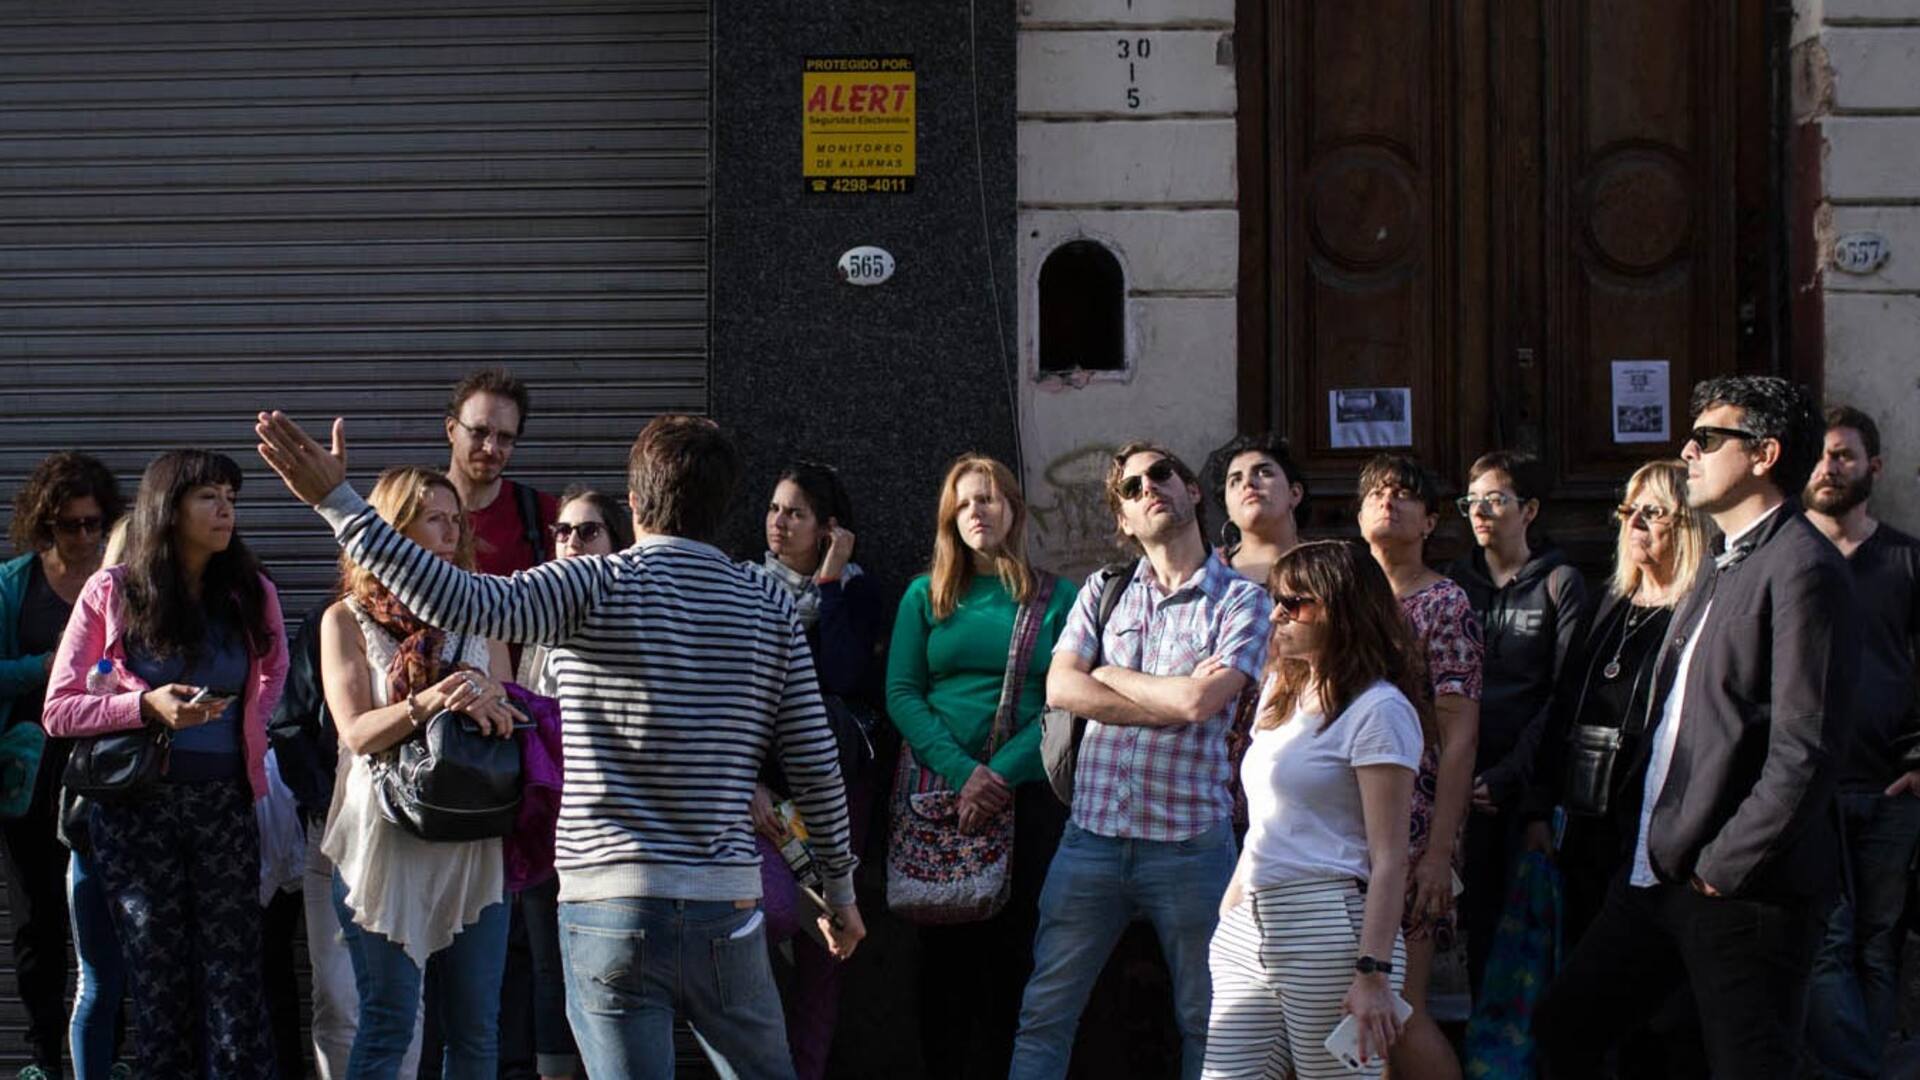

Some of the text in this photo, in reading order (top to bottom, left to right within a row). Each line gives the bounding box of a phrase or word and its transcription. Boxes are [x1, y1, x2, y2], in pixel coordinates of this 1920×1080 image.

[806, 59, 912, 70] PROTEGIDO POR:
[807, 84, 911, 113] ALERT
[1127, 88, 1140, 109] 5
[809, 116, 856, 127] Seguridad
[816, 143, 903, 154] MONITOREO
[816, 159, 903, 169] DE ALARMAS
[832, 179, 907, 192] 4298-4011
[850, 255, 884, 278] 565
